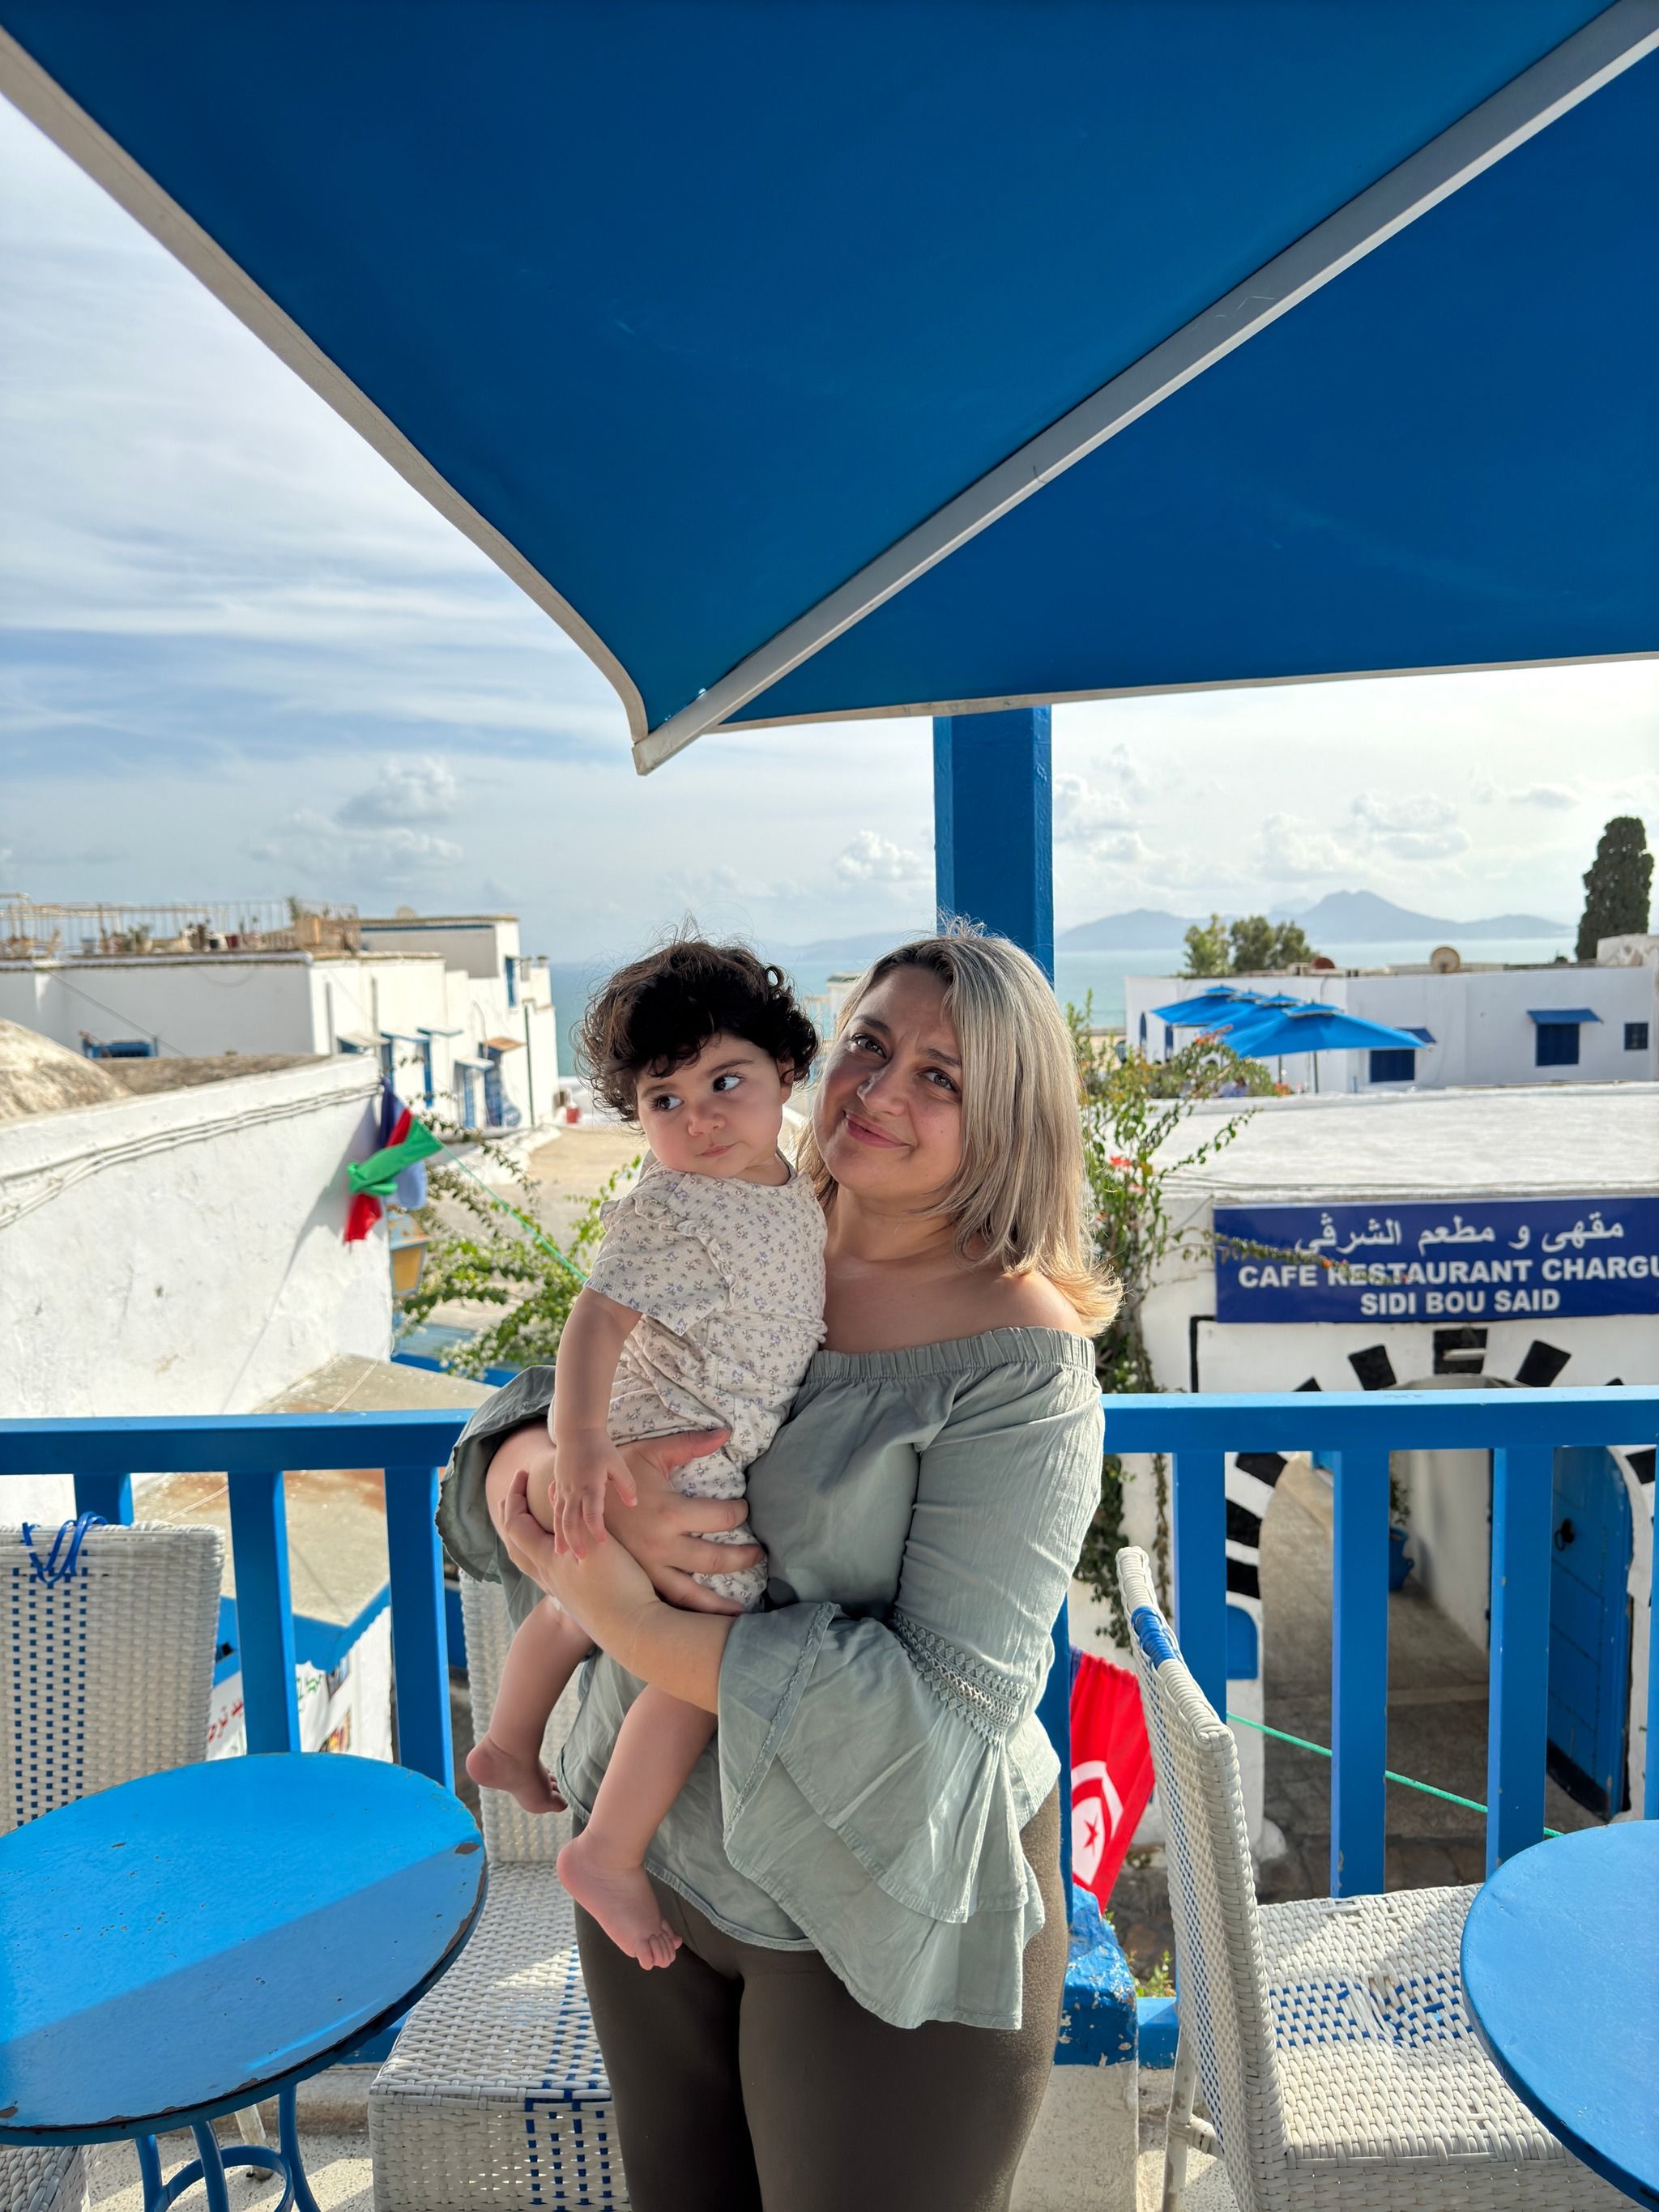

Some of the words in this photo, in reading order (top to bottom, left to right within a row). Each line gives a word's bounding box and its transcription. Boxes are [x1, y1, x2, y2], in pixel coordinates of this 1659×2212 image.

[1418, 1214, 1496, 1257] مطعم
[1508, 1225, 1531, 1250] و
[1542, 1211, 1624, 1253] مقهى
[1238, 1264, 1317, 1288] CAFE
[1326, 1259, 1533, 1287] RESTAURANT
[1360, 1291, 1417, 1316] SIDI
[1426, 1290, 1486, 1315] BOU
[1494, 1289, 1560, 1313] SAID
